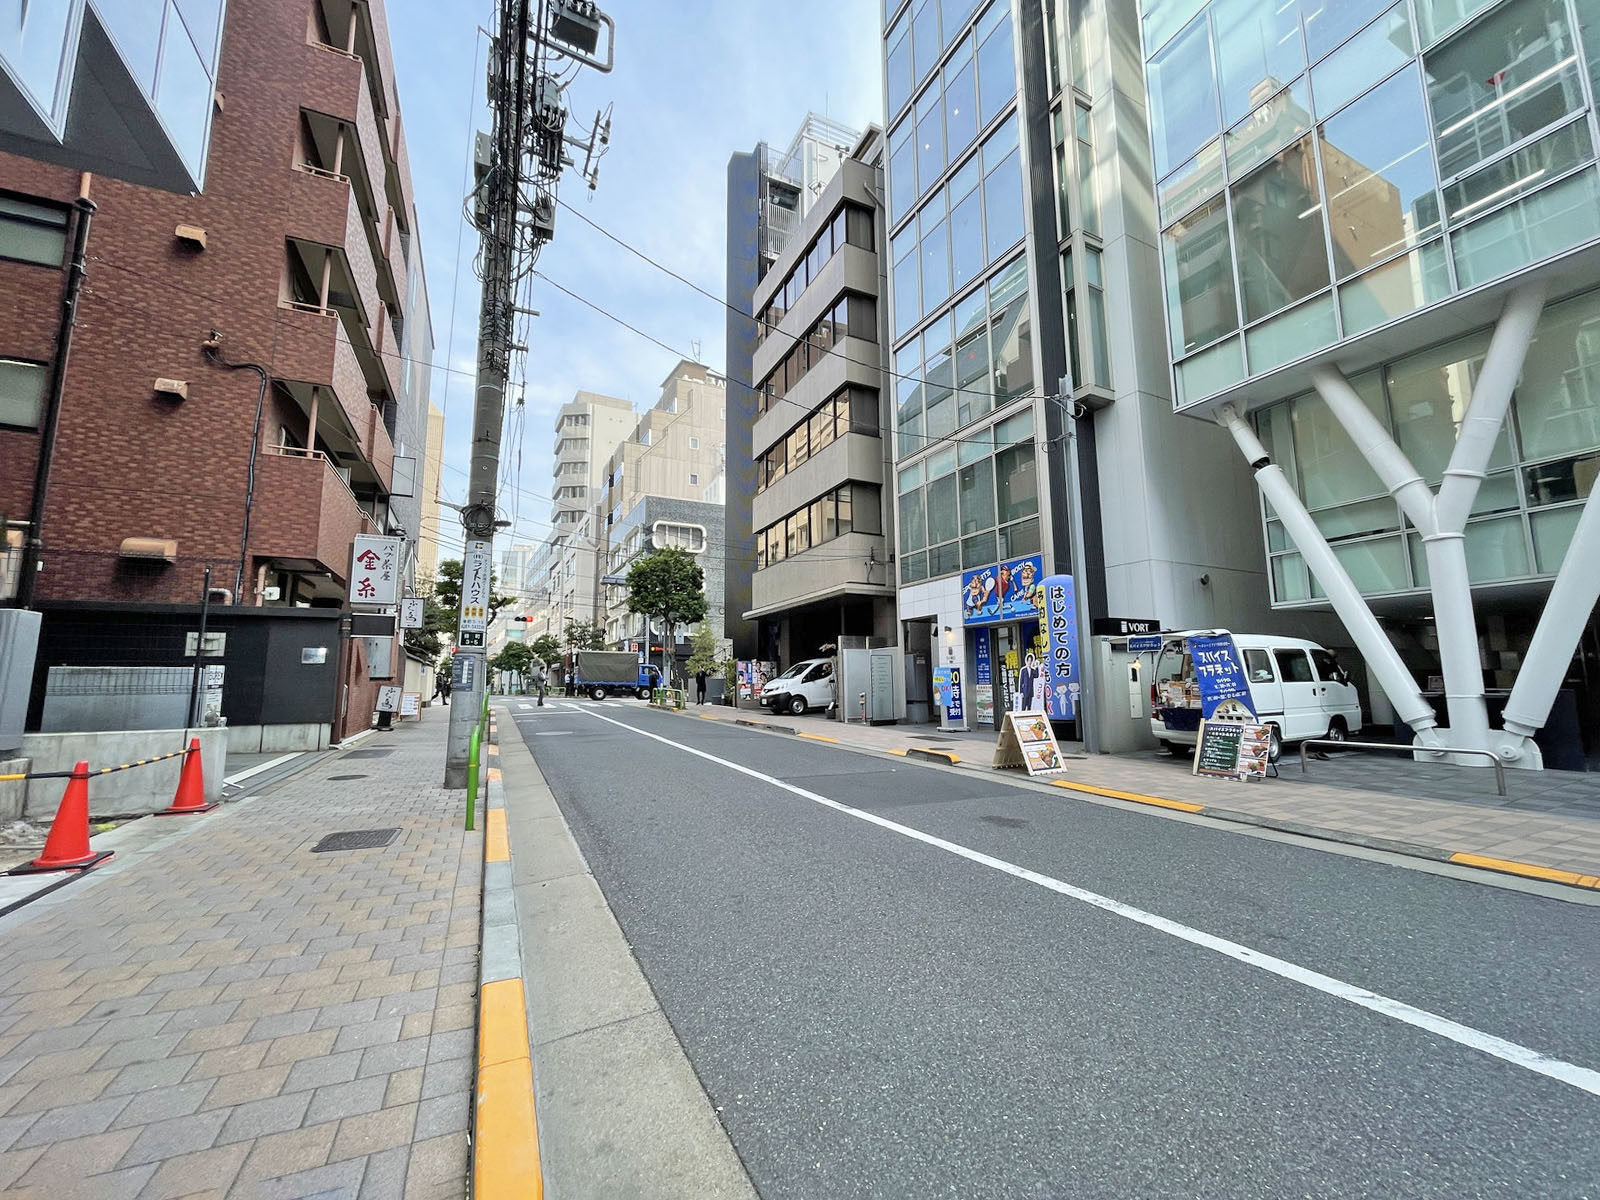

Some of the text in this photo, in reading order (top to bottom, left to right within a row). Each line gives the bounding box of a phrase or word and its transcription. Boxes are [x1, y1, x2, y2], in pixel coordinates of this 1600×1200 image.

[356, 549, 381, 598] 金糸
[1049, 585, 1072, 678] はじめての方
[1128, 622, 1149, 632] VORT
[1197, 650, 1232, 664] スパイス
